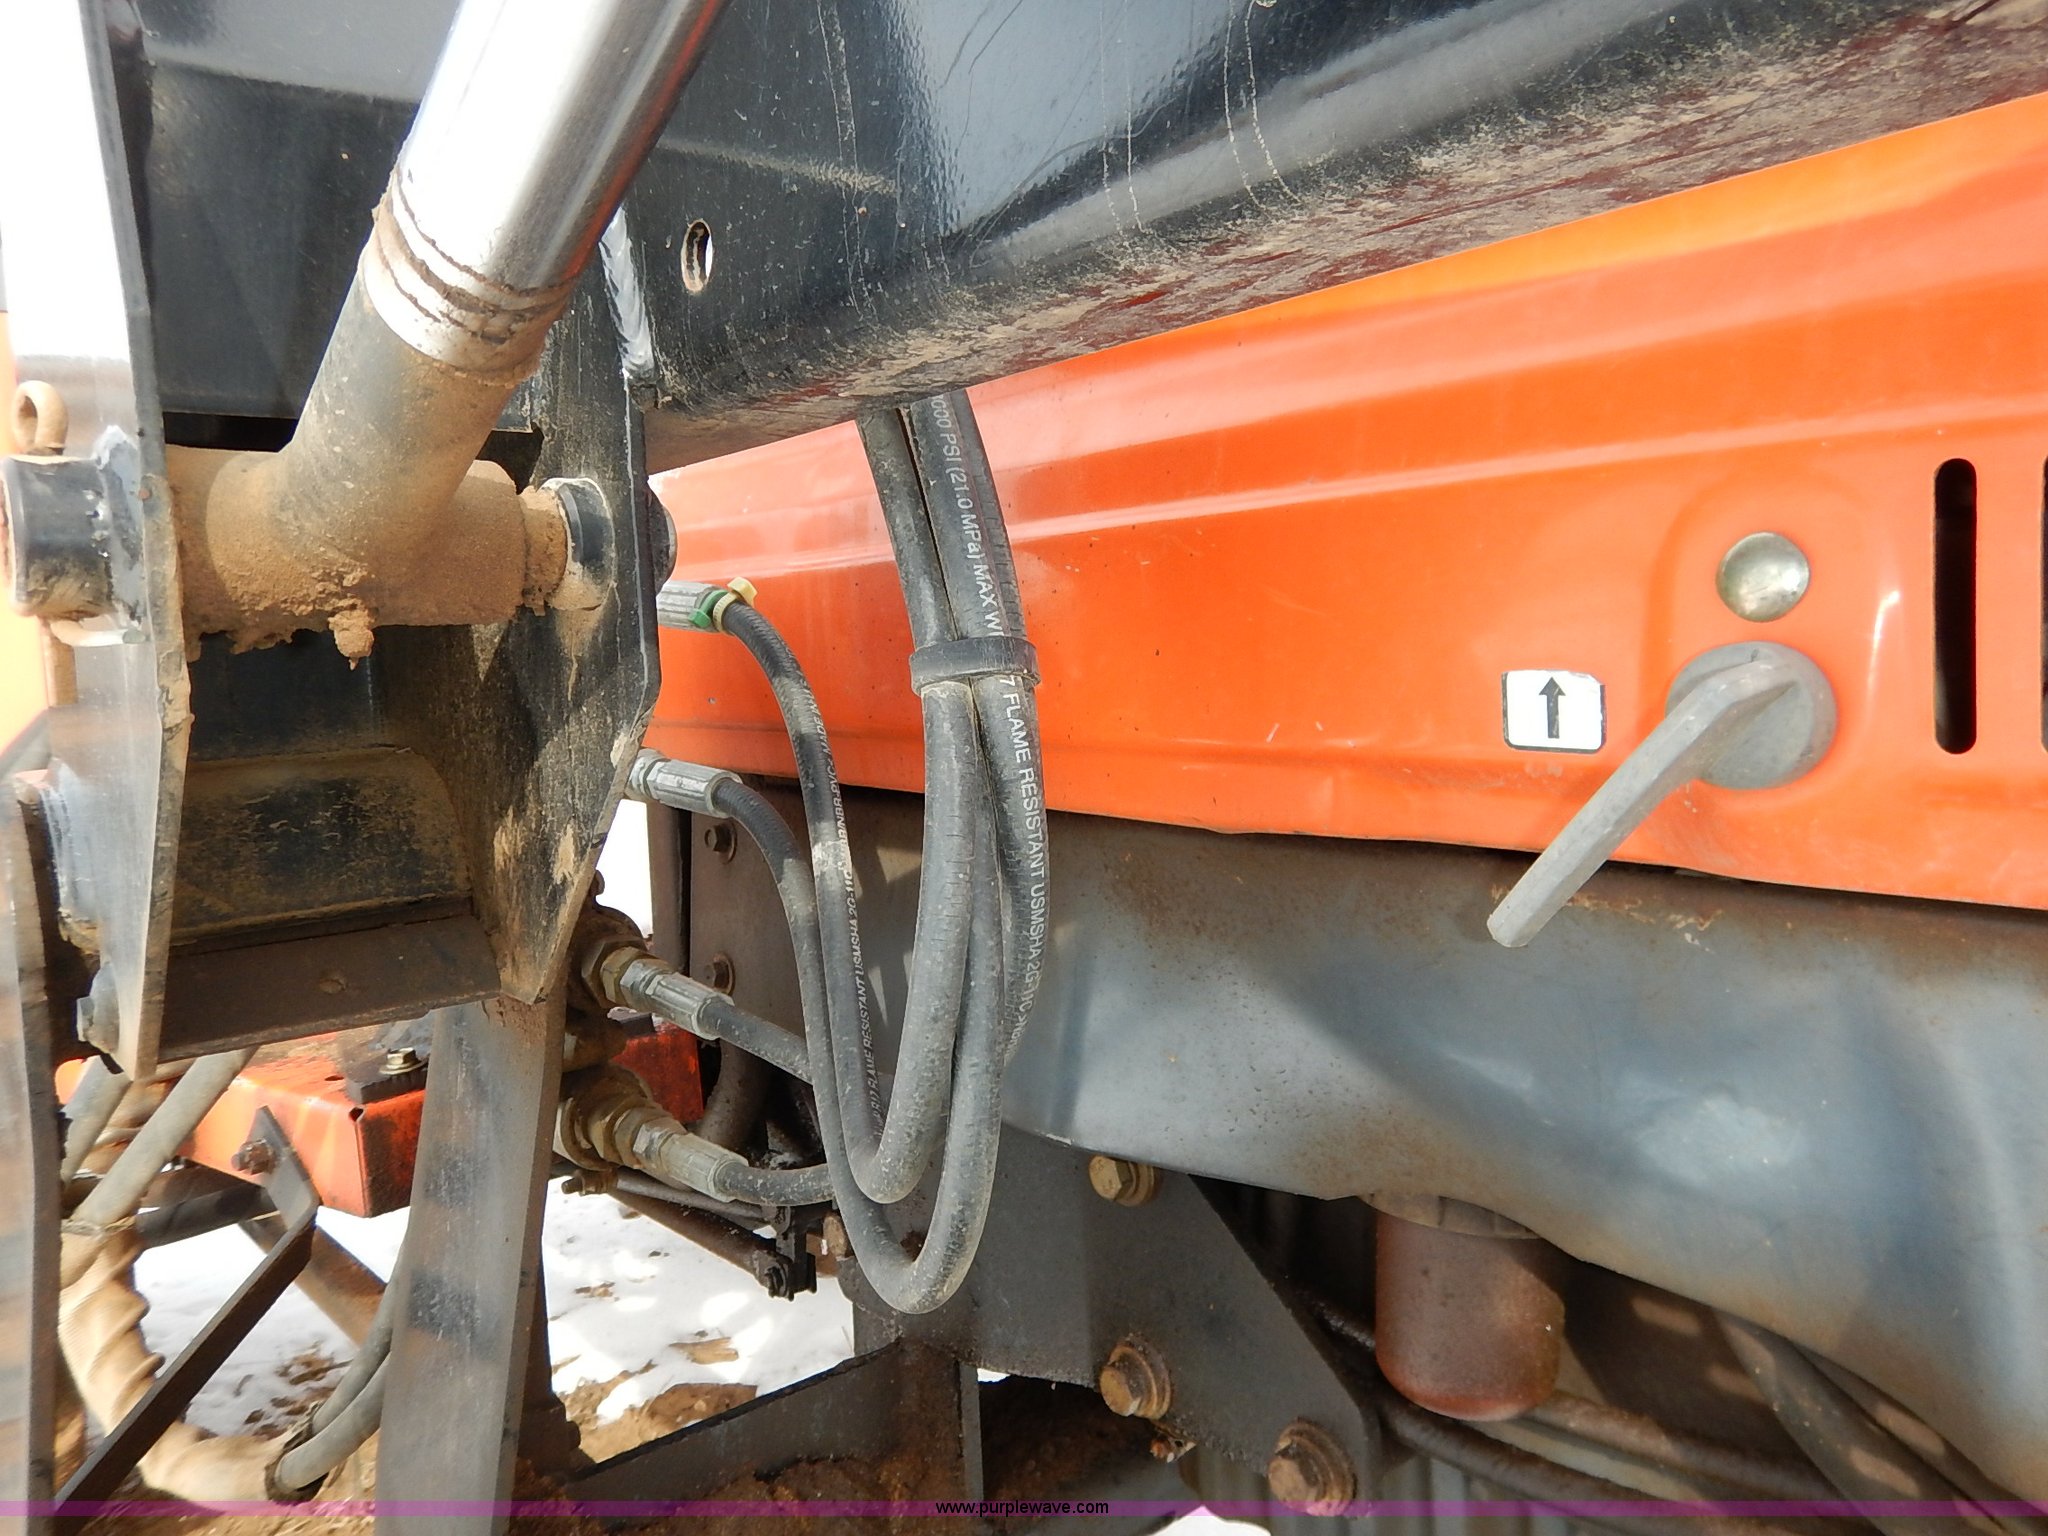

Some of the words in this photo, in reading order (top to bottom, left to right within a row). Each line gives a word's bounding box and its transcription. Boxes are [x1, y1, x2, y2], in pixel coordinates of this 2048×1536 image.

[931, 394, 952, 429] 000
[940, 433, 962, 462] PSI
[945, 467, 973, 510] (21.0
[960, 514, 986, 559] MPa)
[973, 564, 998, 608] MAX
[1003, 692, 1032, 763] FLAME
[1019, 767, 1045, 878] RESISTANT
[1029, 882, 1046, 960] USMSHA
[855, 976, 873, 1050] RESISTANT
